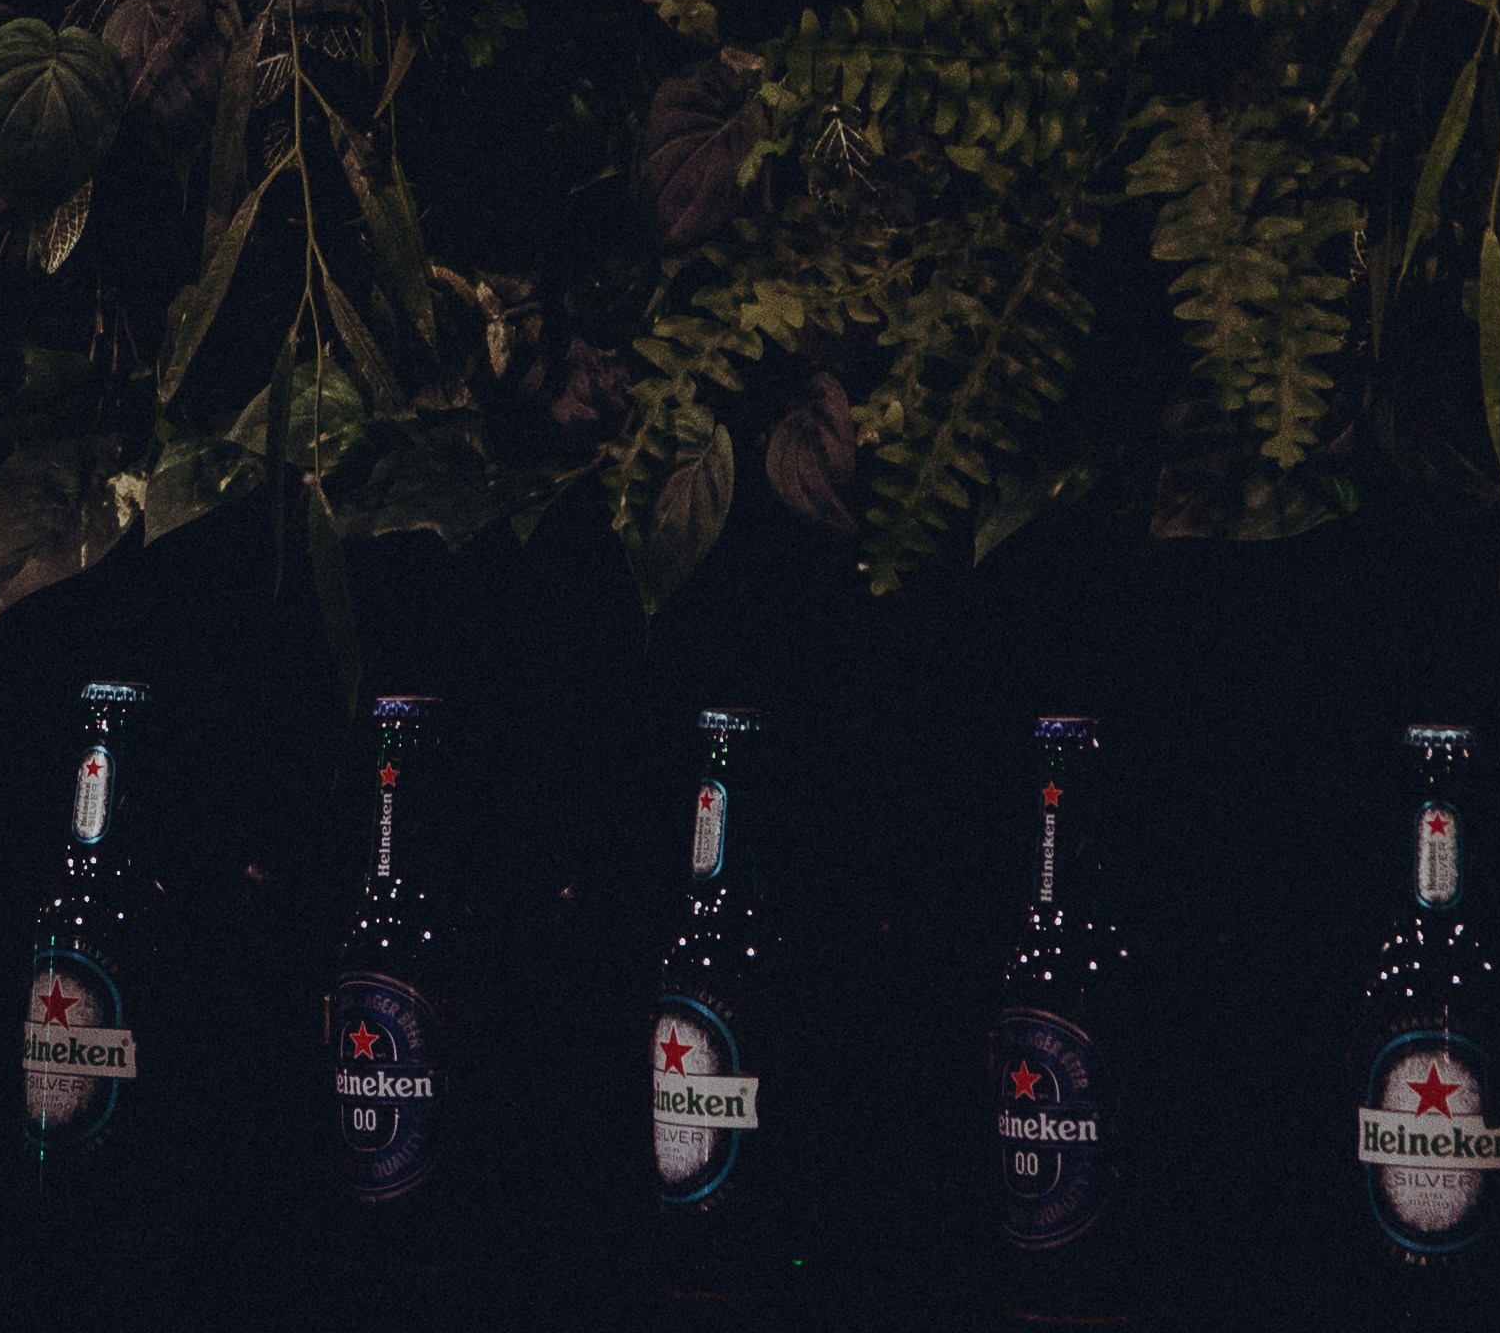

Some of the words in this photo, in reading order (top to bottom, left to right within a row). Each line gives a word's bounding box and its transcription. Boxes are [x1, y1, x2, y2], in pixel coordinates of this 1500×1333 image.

[378, 793, 392, 877] Heineken
[1040, 813, 1056, 902] Heineken
[25, 1033, 127, 1068] eineken
[336, 1068, 434, 1097] eineken
[654, 1082, 747, 1118] ineken
[999, 1109, 1098, 1142] eineken
